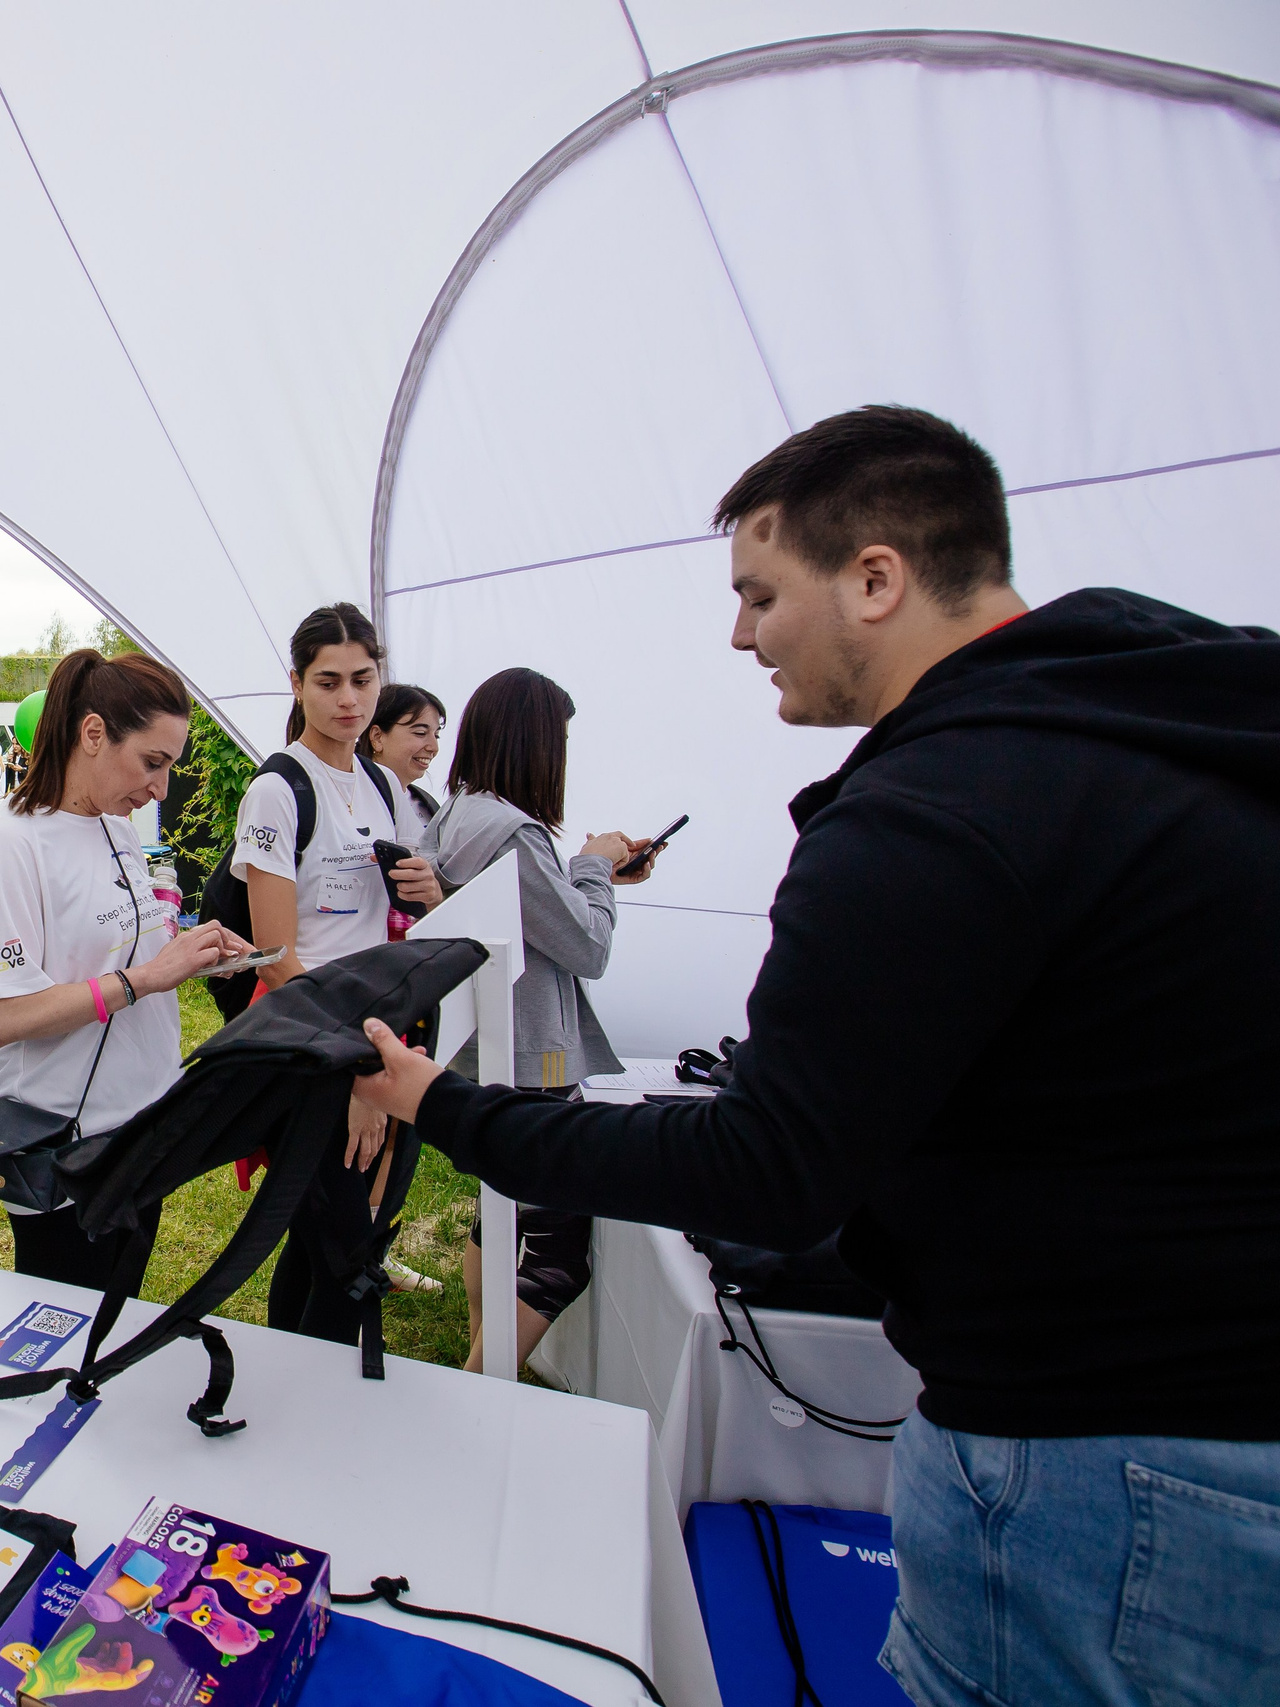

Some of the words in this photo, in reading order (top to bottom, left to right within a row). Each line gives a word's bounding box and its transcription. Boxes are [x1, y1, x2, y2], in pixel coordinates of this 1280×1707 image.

[326, 883, 353, 891] MARIA
[96, 908, 120, 925] Step
[118, 904, 128, 914] it,
[119, 917, 136, 932] Ever
[139, 910, 152, 921] ove
[21, 1340, 52, 1366] wellYOU
[10, 1461, 36, 1489] wellYOU
[148, 1507, 183, 1550] COLORS
[168, 1519, 217, 1557] 18
[41, 1600, 71, 1617] ppy
[42, 1588, 77, 1608] lidays
[2, 1689, 17, 1705] ring
[194, 1672, 219, 1704] AIR
